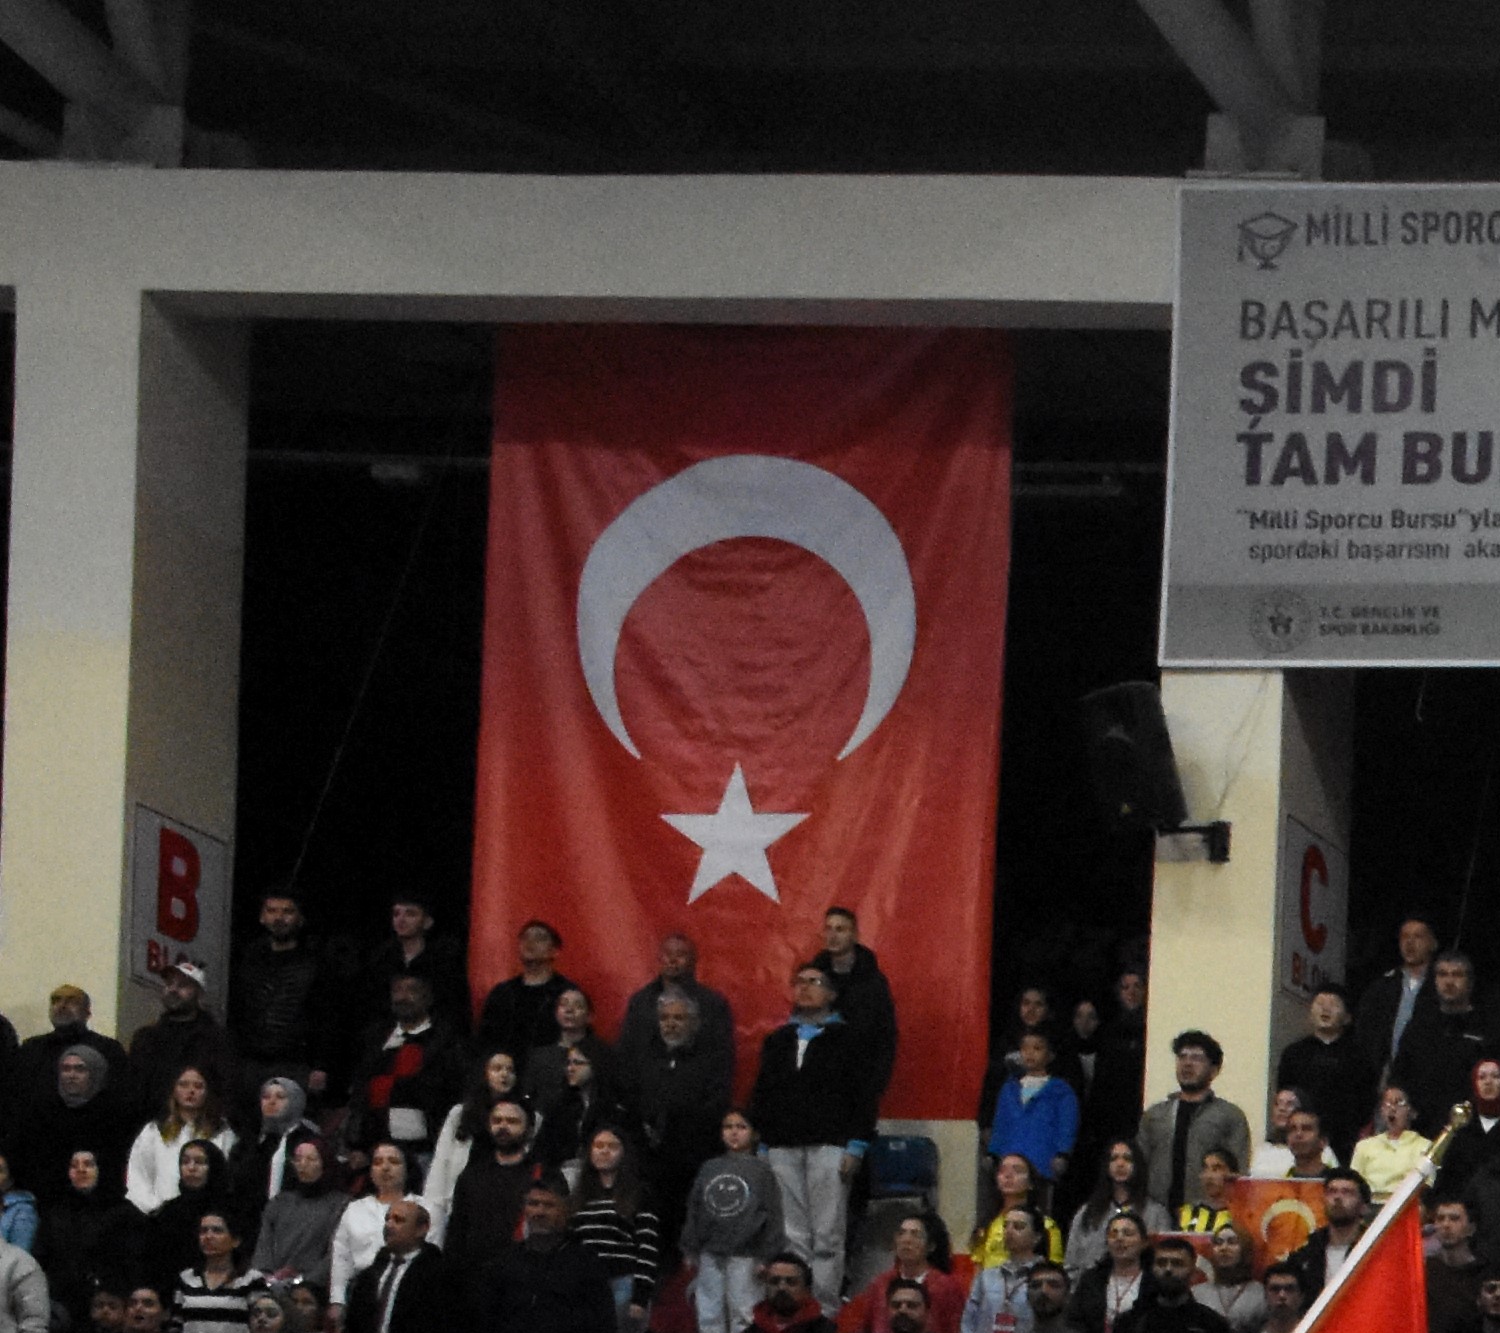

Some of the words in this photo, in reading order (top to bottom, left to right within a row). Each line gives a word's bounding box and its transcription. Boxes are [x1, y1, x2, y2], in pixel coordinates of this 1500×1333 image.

[1306, 205, 1390, 246] MİLLİ
[1239, 298, 1450, 348] BAŞARILI
[1239, 348, 1438, 428] ŞİMDİ
[1237, 429, 1378, 486] TAM
[1304, 508, 1381, 535] Sporcu
[1248, 538, 1340, 563] spordaki
[1347, 538, 1450, 563] başarısını
[156, 826, 202, 943] B
[1299, 844, 1329, 955] C
